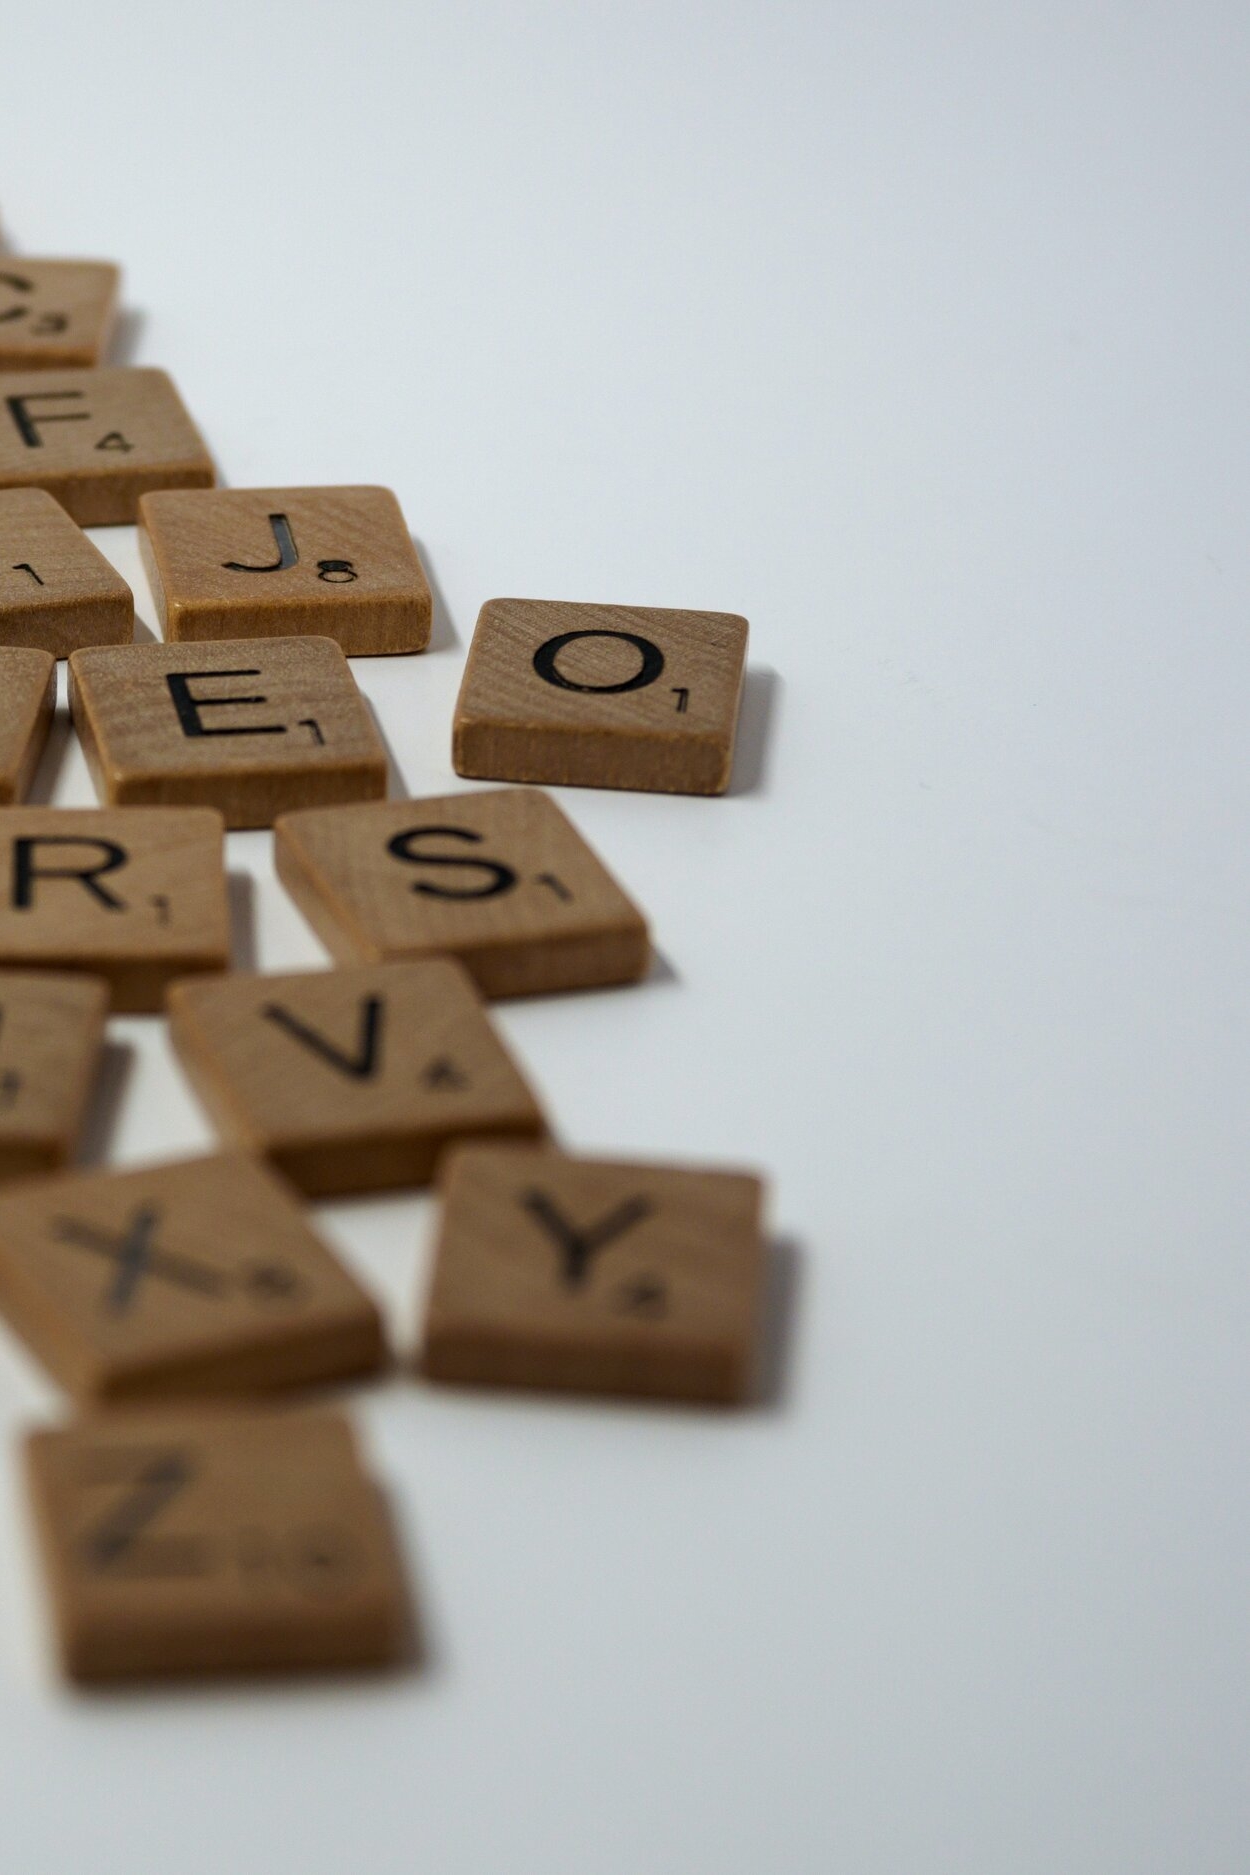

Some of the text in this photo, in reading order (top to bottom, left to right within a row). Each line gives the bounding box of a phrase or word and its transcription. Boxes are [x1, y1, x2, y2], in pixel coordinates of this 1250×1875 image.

[4, 391, 135, 455] F 4
[11, 562, 45, 586] 1
[221, 512, 359, 584] J 8
[165, 668, 325, 747] E 1
[531, 628, 690, 714] O 1
[10, 835, 128, 912] R
[385, 825, 517, 901] S
[261, 994, 385, 1084] V
[53, 1206, 226, 1315] X
[520, 1188, 652, 1292] Y
[78, 1447, 207, 1578] Z
